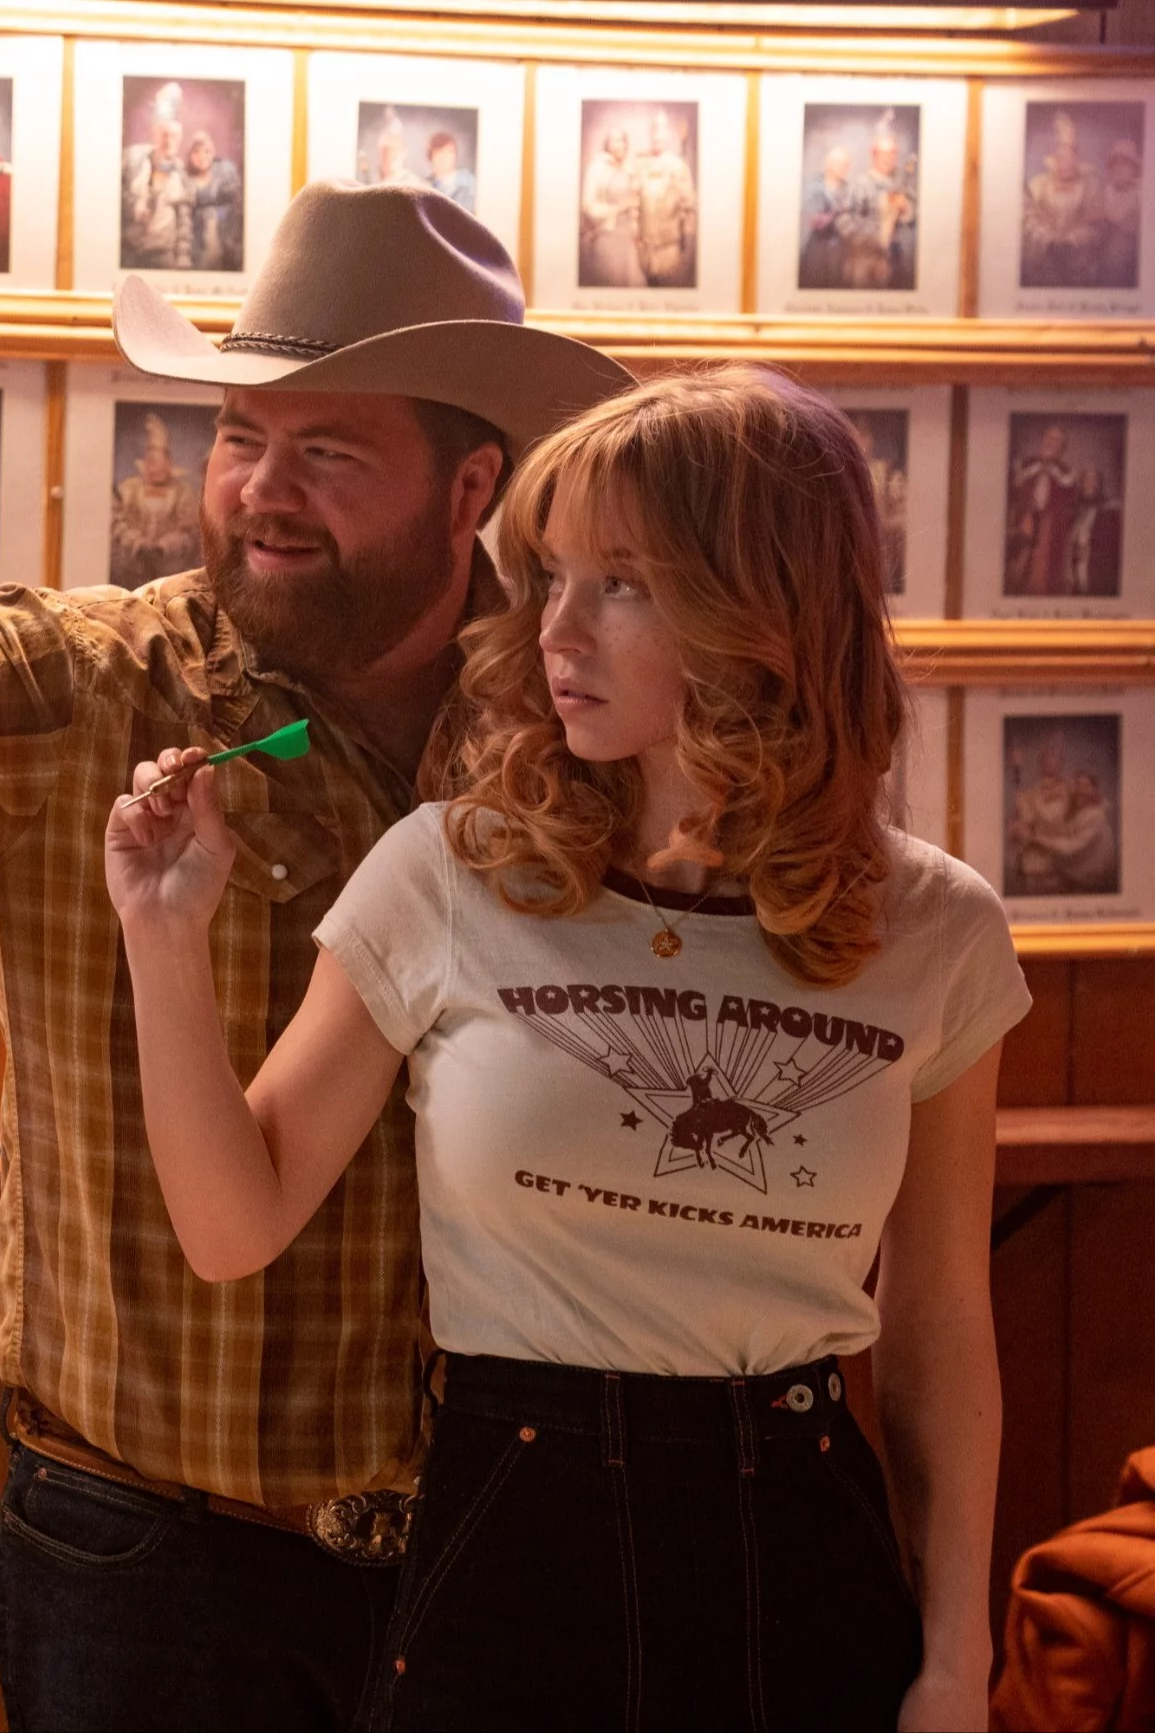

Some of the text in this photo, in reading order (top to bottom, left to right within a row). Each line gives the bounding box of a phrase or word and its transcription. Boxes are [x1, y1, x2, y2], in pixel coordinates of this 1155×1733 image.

[497, 984, 905, 1063] HORSING AROUND
[514, 1170, 571, 1197] GET
[647, 1199, 734, 1226] KICKS
[739, 1214, 862, 1239] AMERICA
